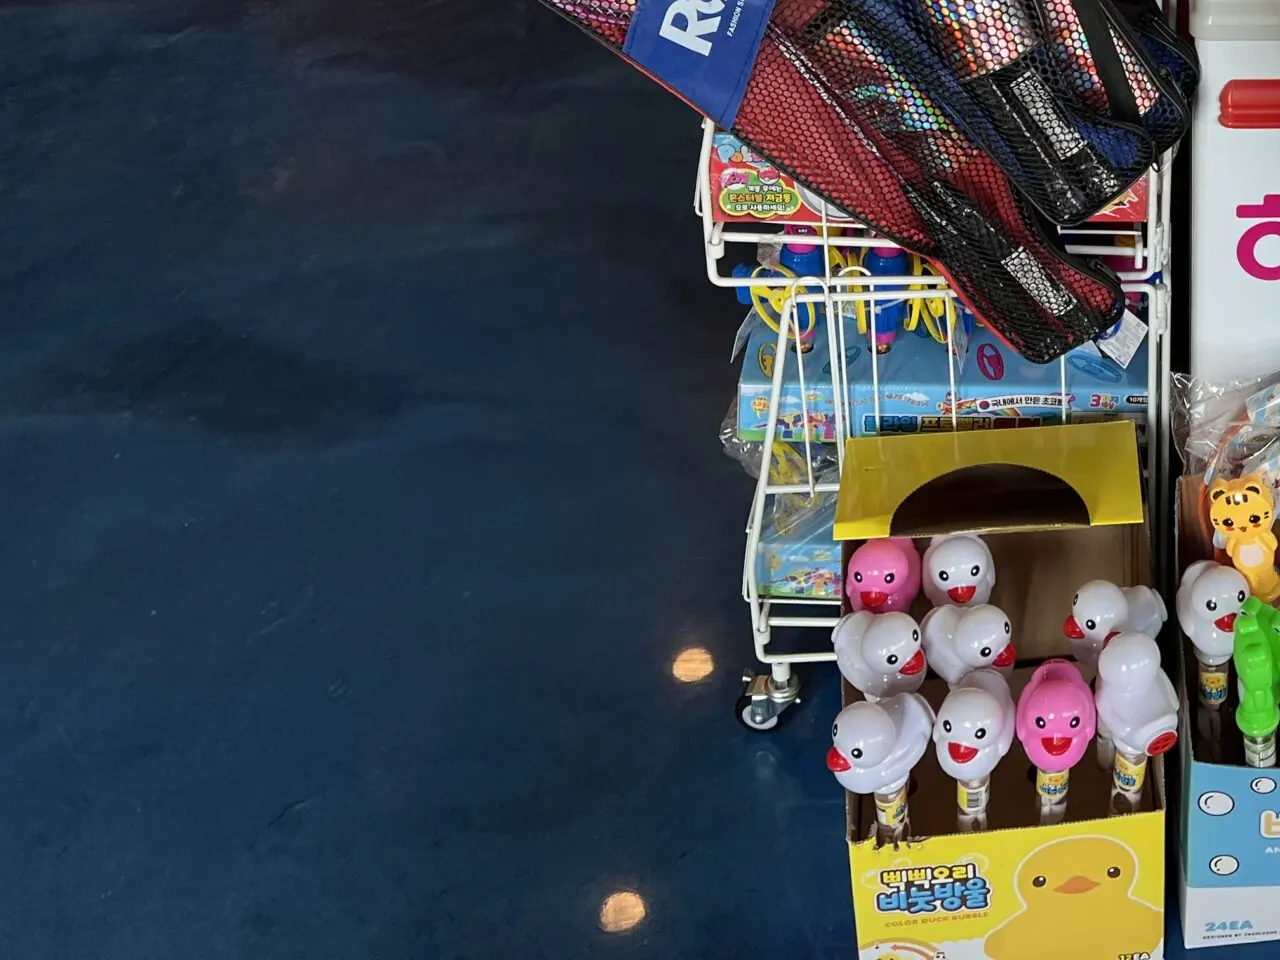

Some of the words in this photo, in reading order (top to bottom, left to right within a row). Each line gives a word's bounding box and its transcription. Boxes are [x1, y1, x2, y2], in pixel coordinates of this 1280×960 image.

[727, 8, 742, 38] FASHION
[728, 193, 763, 203] 몬스터볼
[765, 193, 791, 203] 저금통
[991, 396, 1024, 408] 국내에서
[1025, 396, 1041, 407] 만든
[877, 876, 993, 915] 비눗방울
[884, 918, 919, 928] COLOR
[921, 914, 950, 925] DUCK
[951, 910, 990, 922] BUBBLE
[1203, 919, 1254, 933] 24EA
